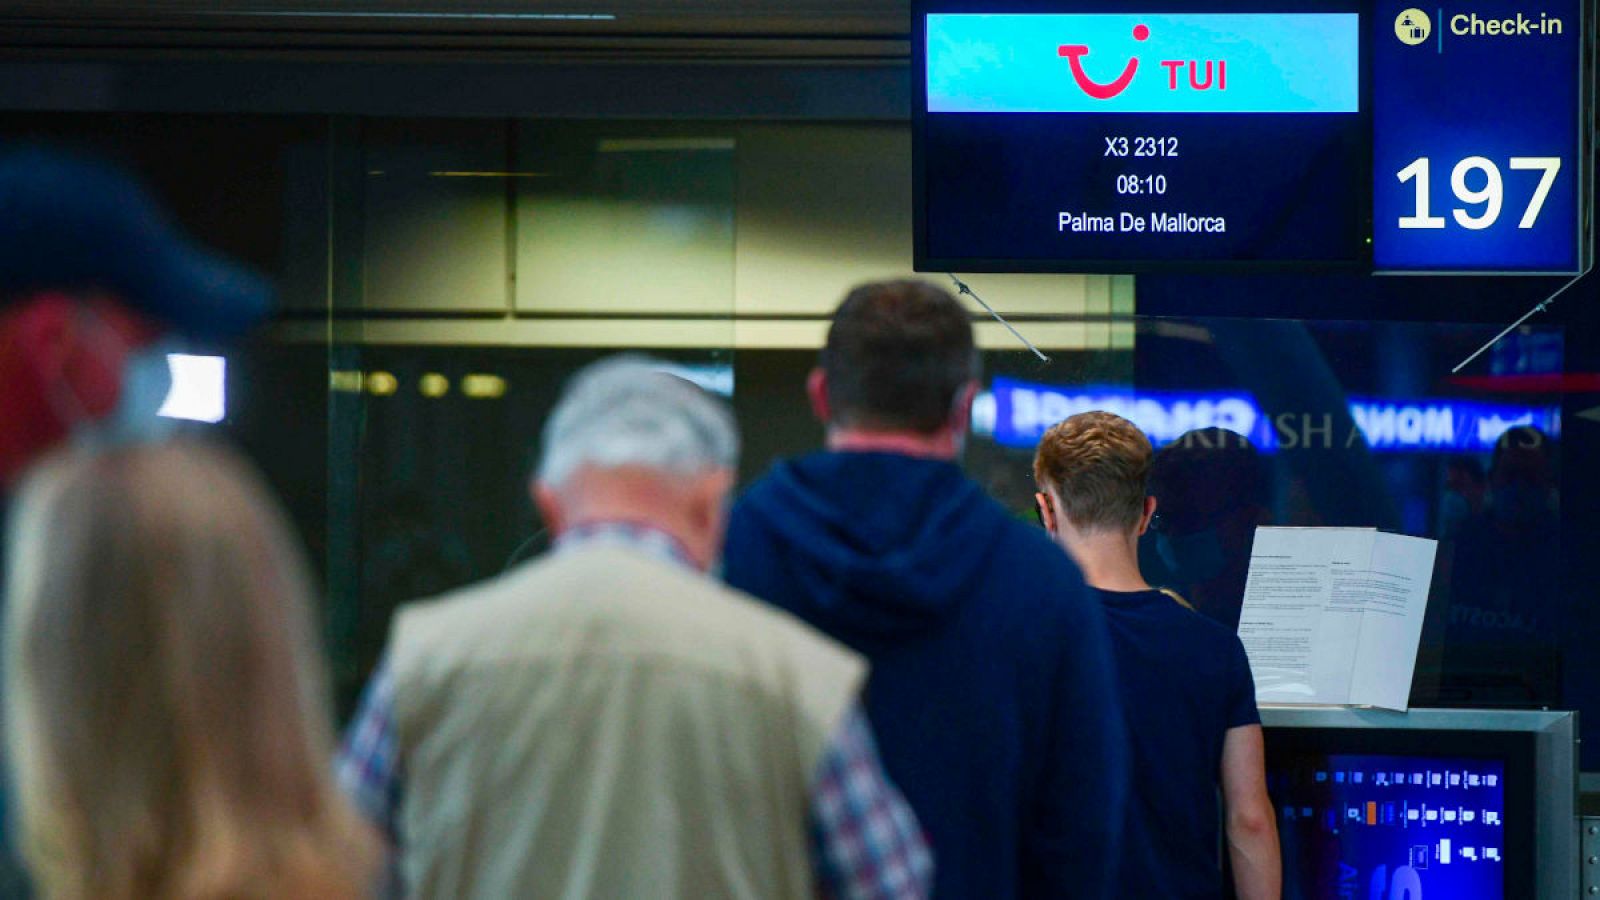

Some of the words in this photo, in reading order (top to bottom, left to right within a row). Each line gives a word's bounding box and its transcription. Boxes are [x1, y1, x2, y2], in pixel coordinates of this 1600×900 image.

[1450, 12, 1562, 36] Check-in
[1162, 60, 1227, 91] TUI
[1104, 136, 1130, 157] X3
[1134, 136, 1178, 157] 2312
[1116, 174, 1166, 195] 08:10
[1396, 155, 1561, 231] 197
[1058, 211, 1114, 232] Palma
[1120, 211, 1146, 232] De
[1151, 211, 1226, 232] Mallorca
